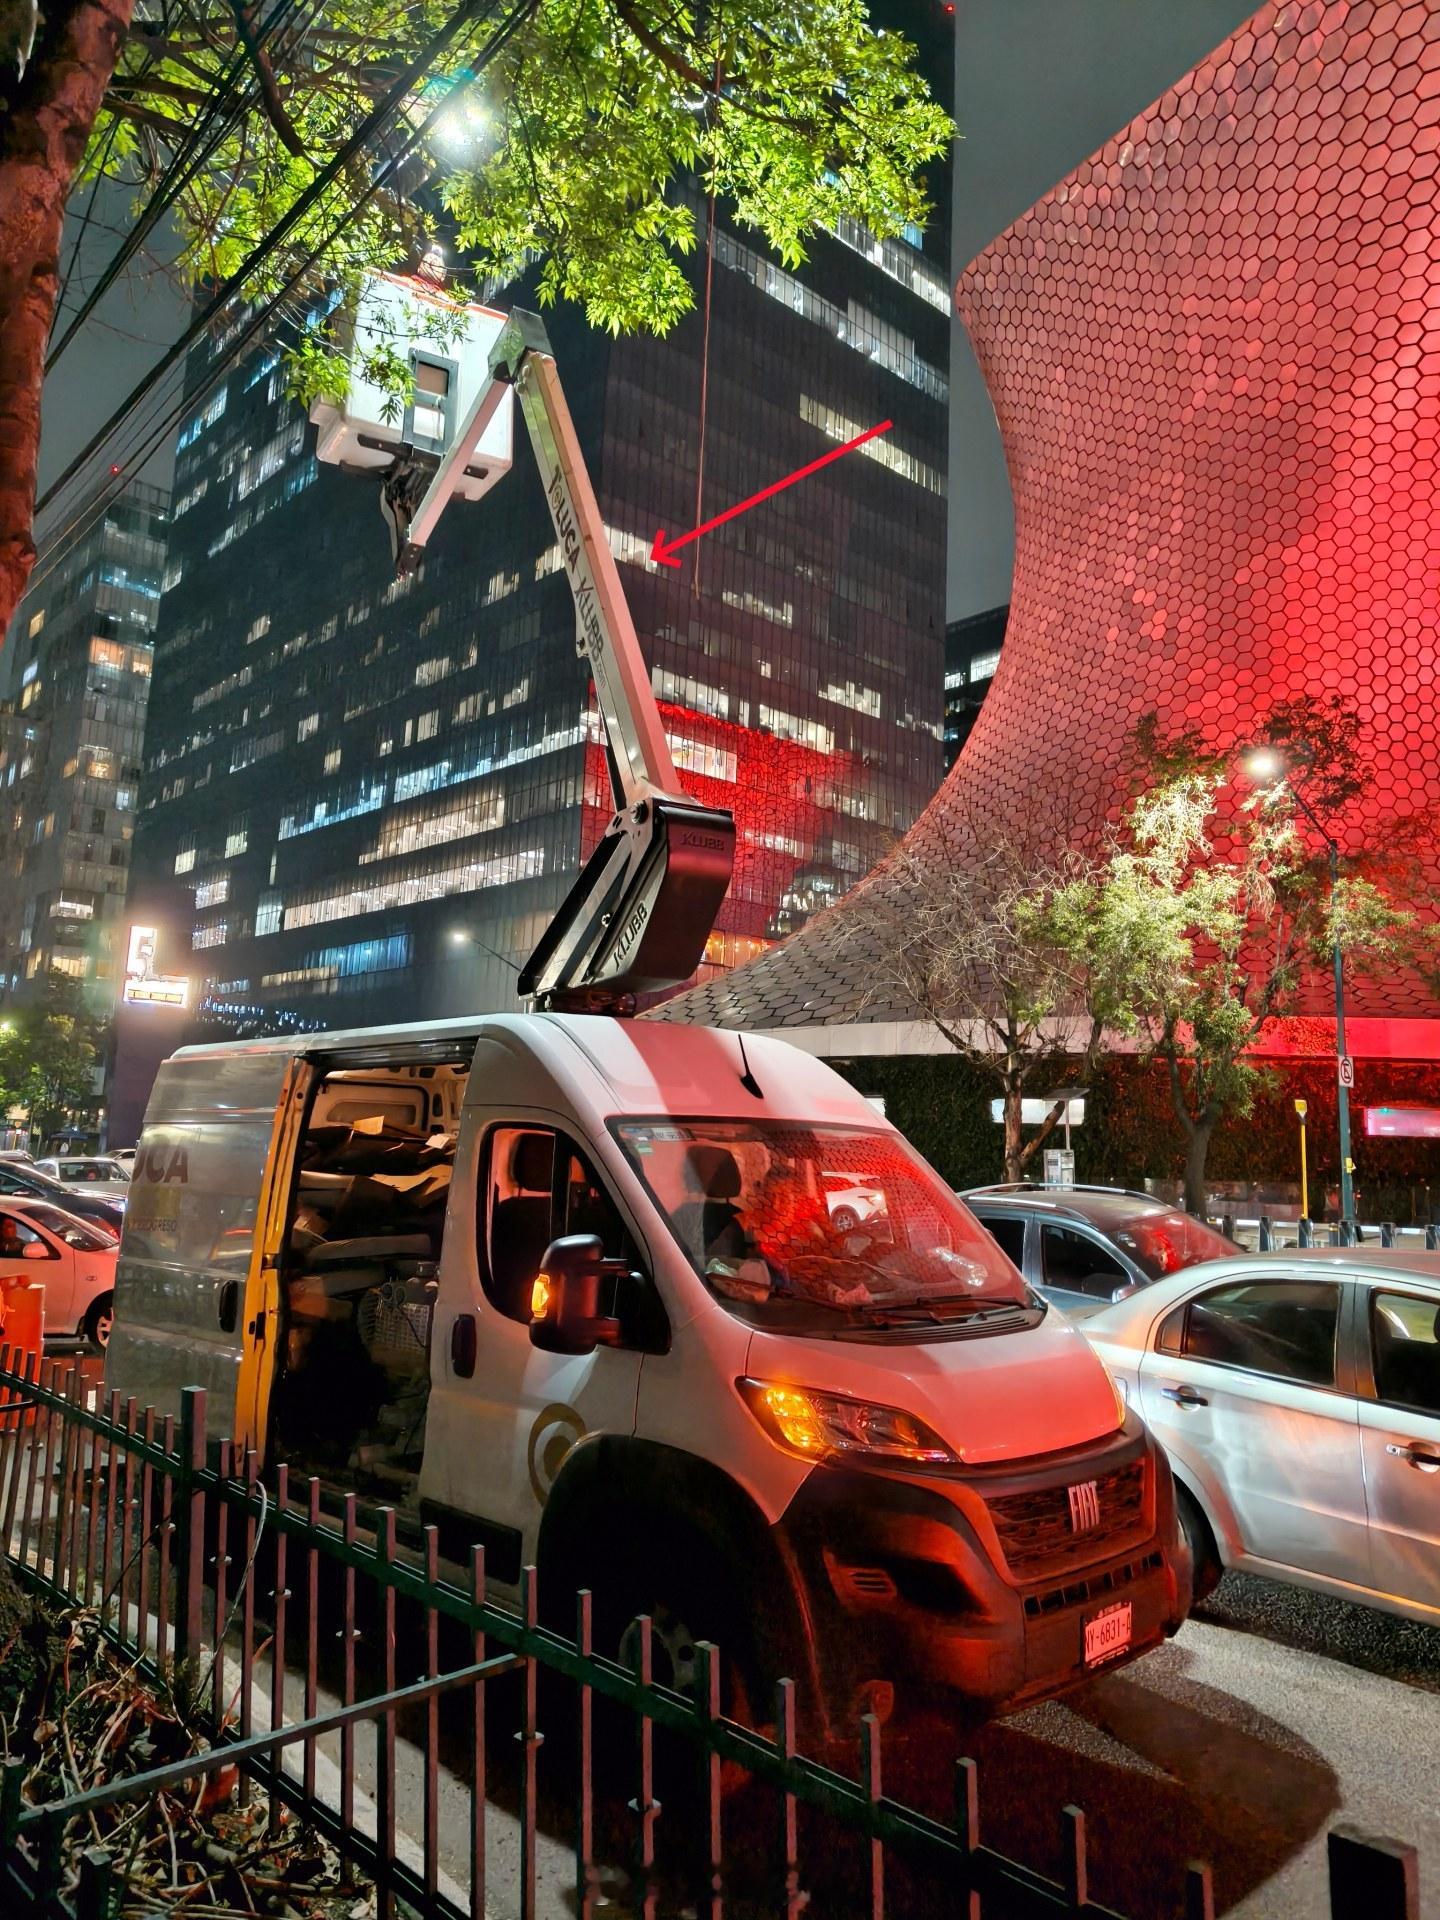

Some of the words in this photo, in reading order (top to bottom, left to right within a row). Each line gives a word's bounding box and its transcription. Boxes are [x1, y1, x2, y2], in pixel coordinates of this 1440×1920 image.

[680, 831, 725, 851] KLUBB
[612, 900, 649, 972] KLUBB
[1068, 1480, 1100, 1533] FIAT
